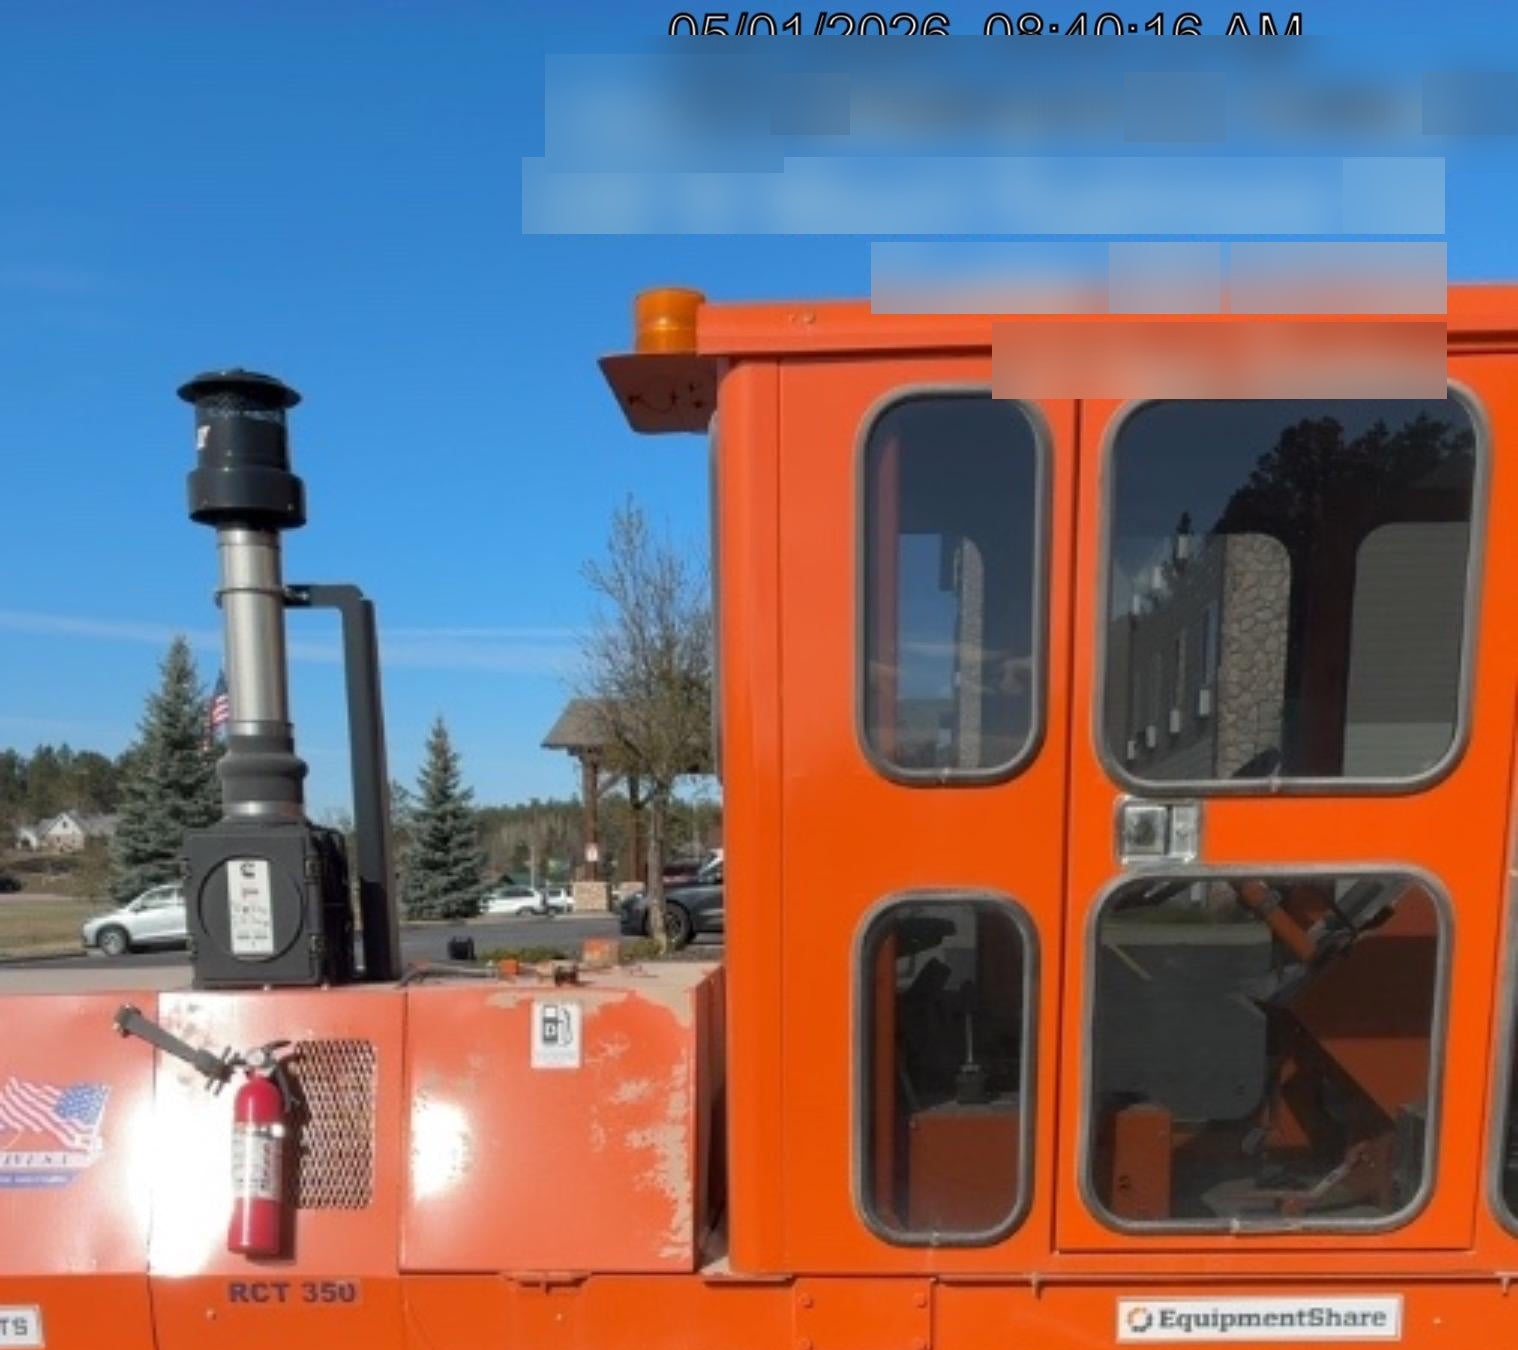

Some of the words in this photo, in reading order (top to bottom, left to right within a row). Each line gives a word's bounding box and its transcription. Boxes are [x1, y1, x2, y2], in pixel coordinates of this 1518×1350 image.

[229, 1281, 290, 1303] RCT
[301, 1282, 356, 1303] 350
[1159, 1308, 1387, 1332] EquipmentShare
